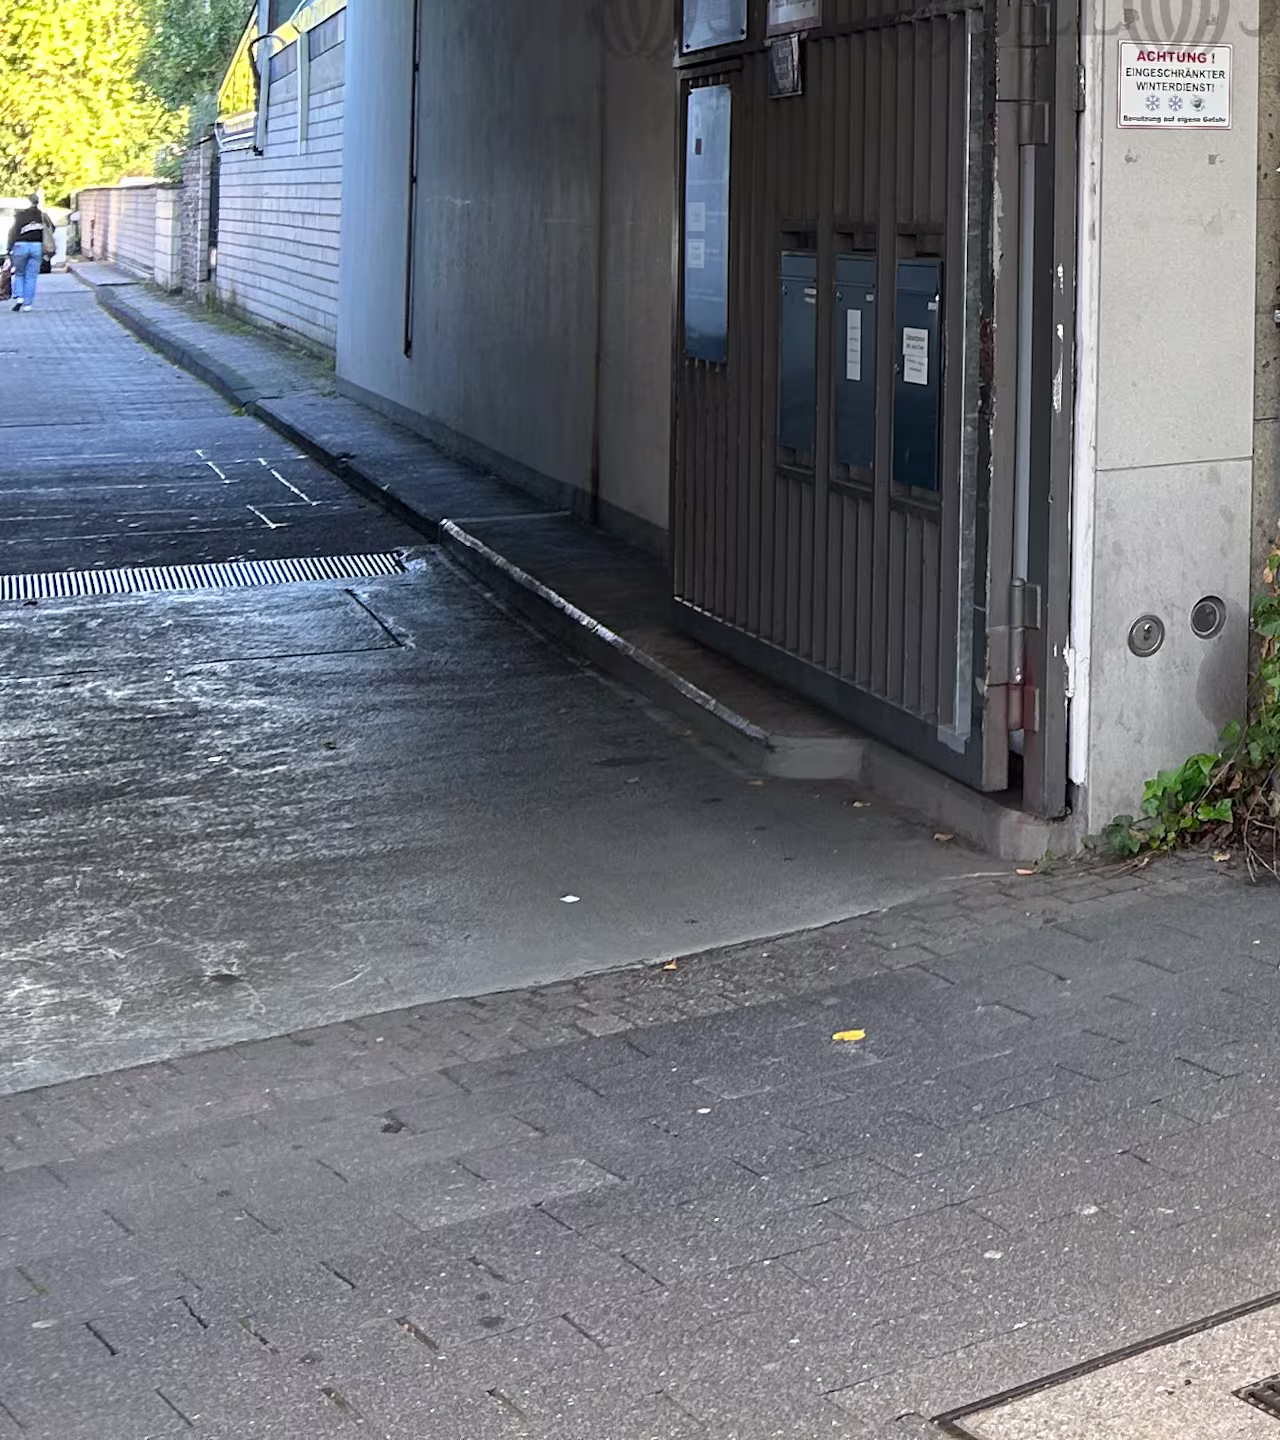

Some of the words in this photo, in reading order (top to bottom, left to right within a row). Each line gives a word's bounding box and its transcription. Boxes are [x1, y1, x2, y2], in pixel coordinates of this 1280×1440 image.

[1136, 50, 1207, 64] ACHTUNG
[1125, 67, 1226, 80] EINGESCHRÄNKTER
[1136, 81, 1216, 93] WINTERDIENST!
